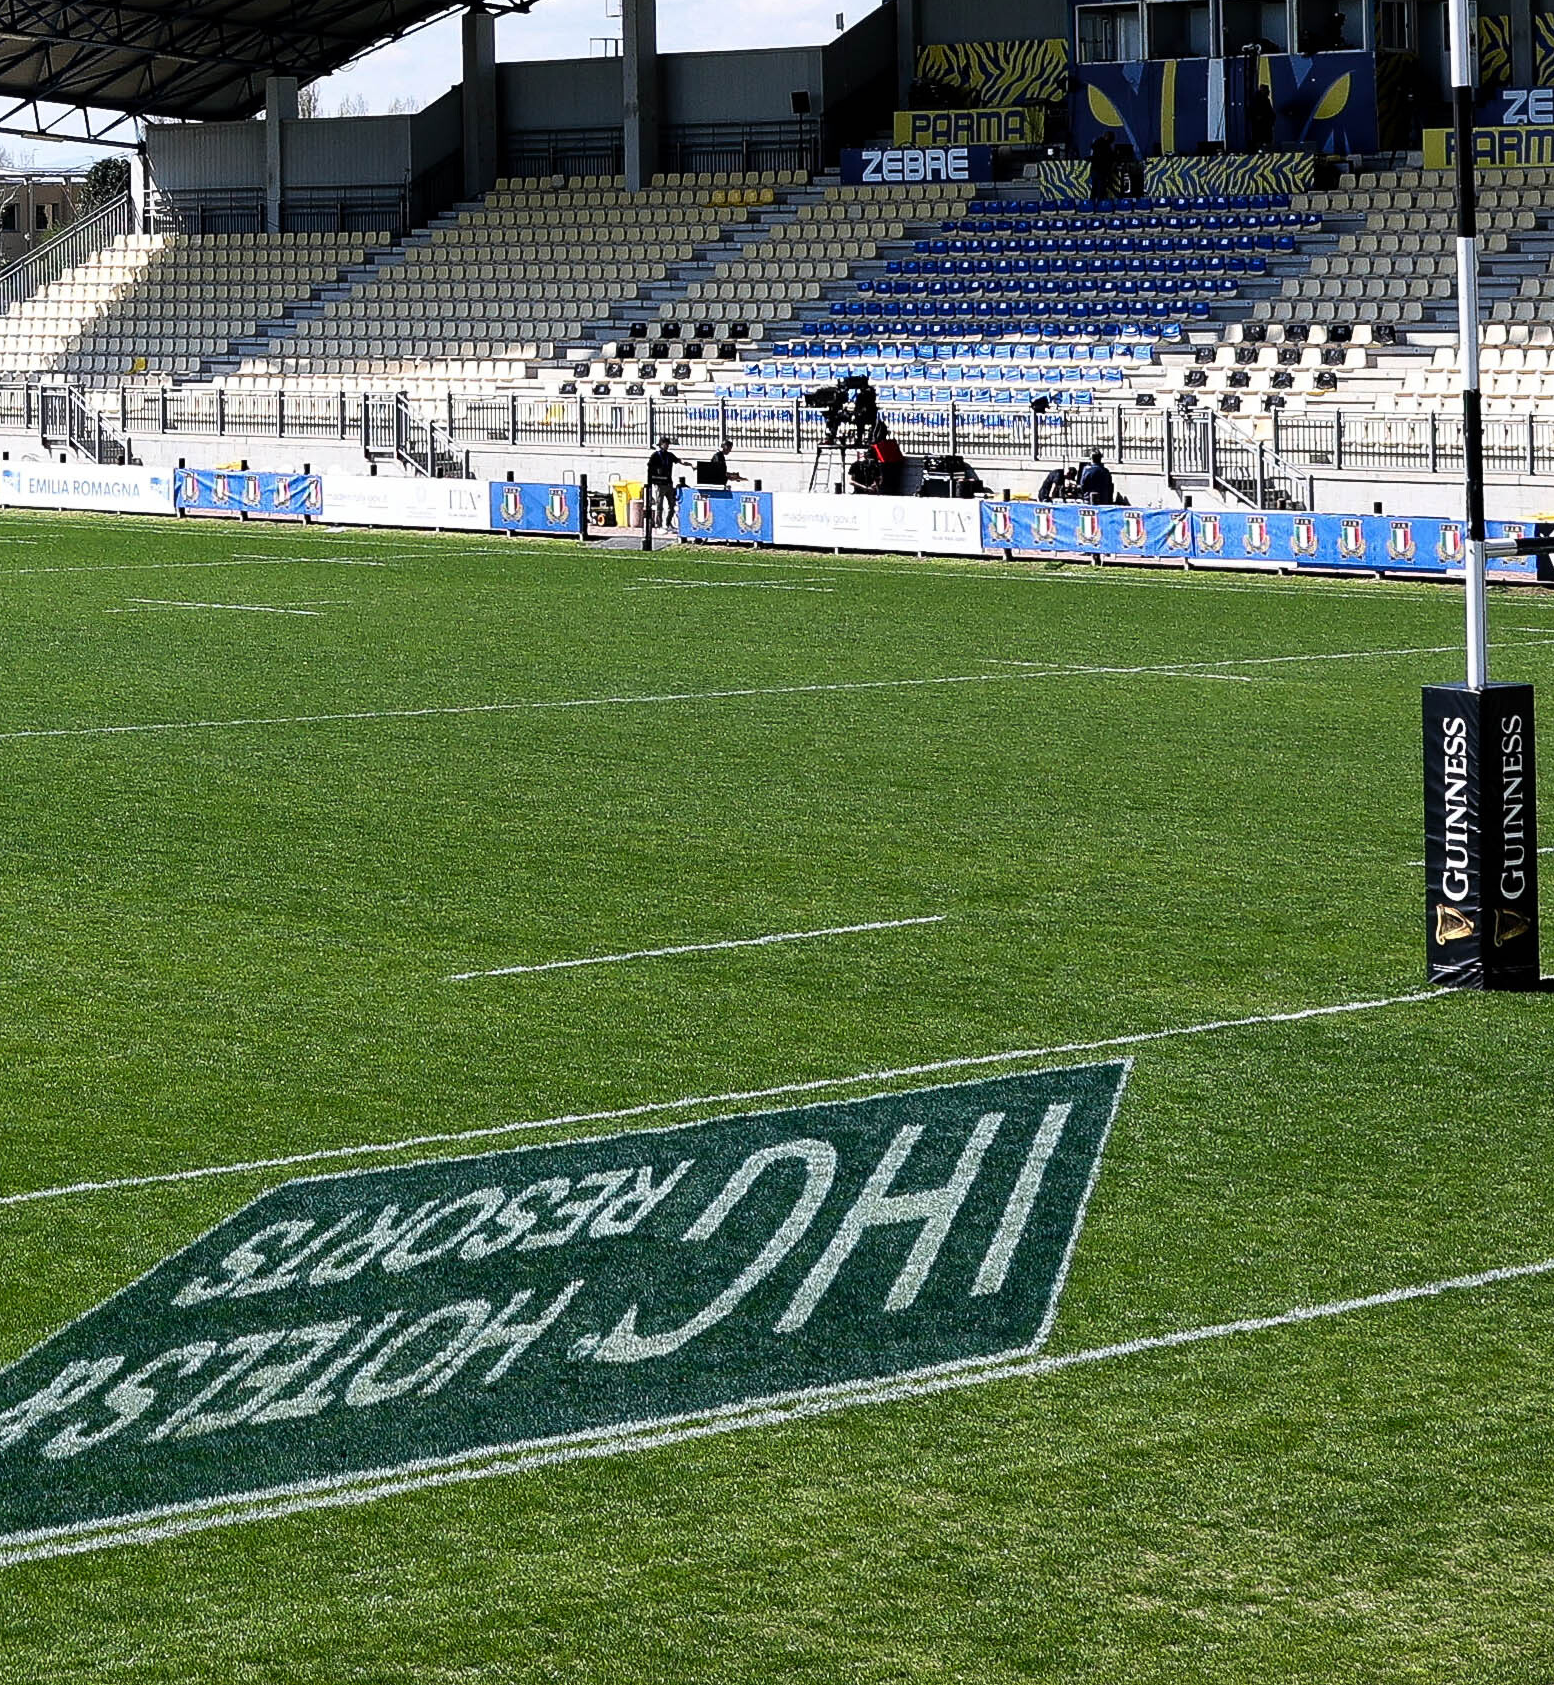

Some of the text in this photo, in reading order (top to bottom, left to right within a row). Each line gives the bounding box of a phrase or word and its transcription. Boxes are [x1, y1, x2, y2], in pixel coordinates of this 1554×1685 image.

[861, 148, 969, 182] ZEBRE
[912, 110, 1025, 144] PARMA
[29, 477, 140, 499] EMILIA ROMAGNA
[932, 509, 967, 533] ITA
[1441, 716, 1468, 902] GUINNESS
[1500, 713, 1524, 901] GUINNESS
[172, 1154, 694, 1308] RESORTS
[584, 1101, 1073, 1363] IHG
[96, 1278, 585, 1446] HOTELS
